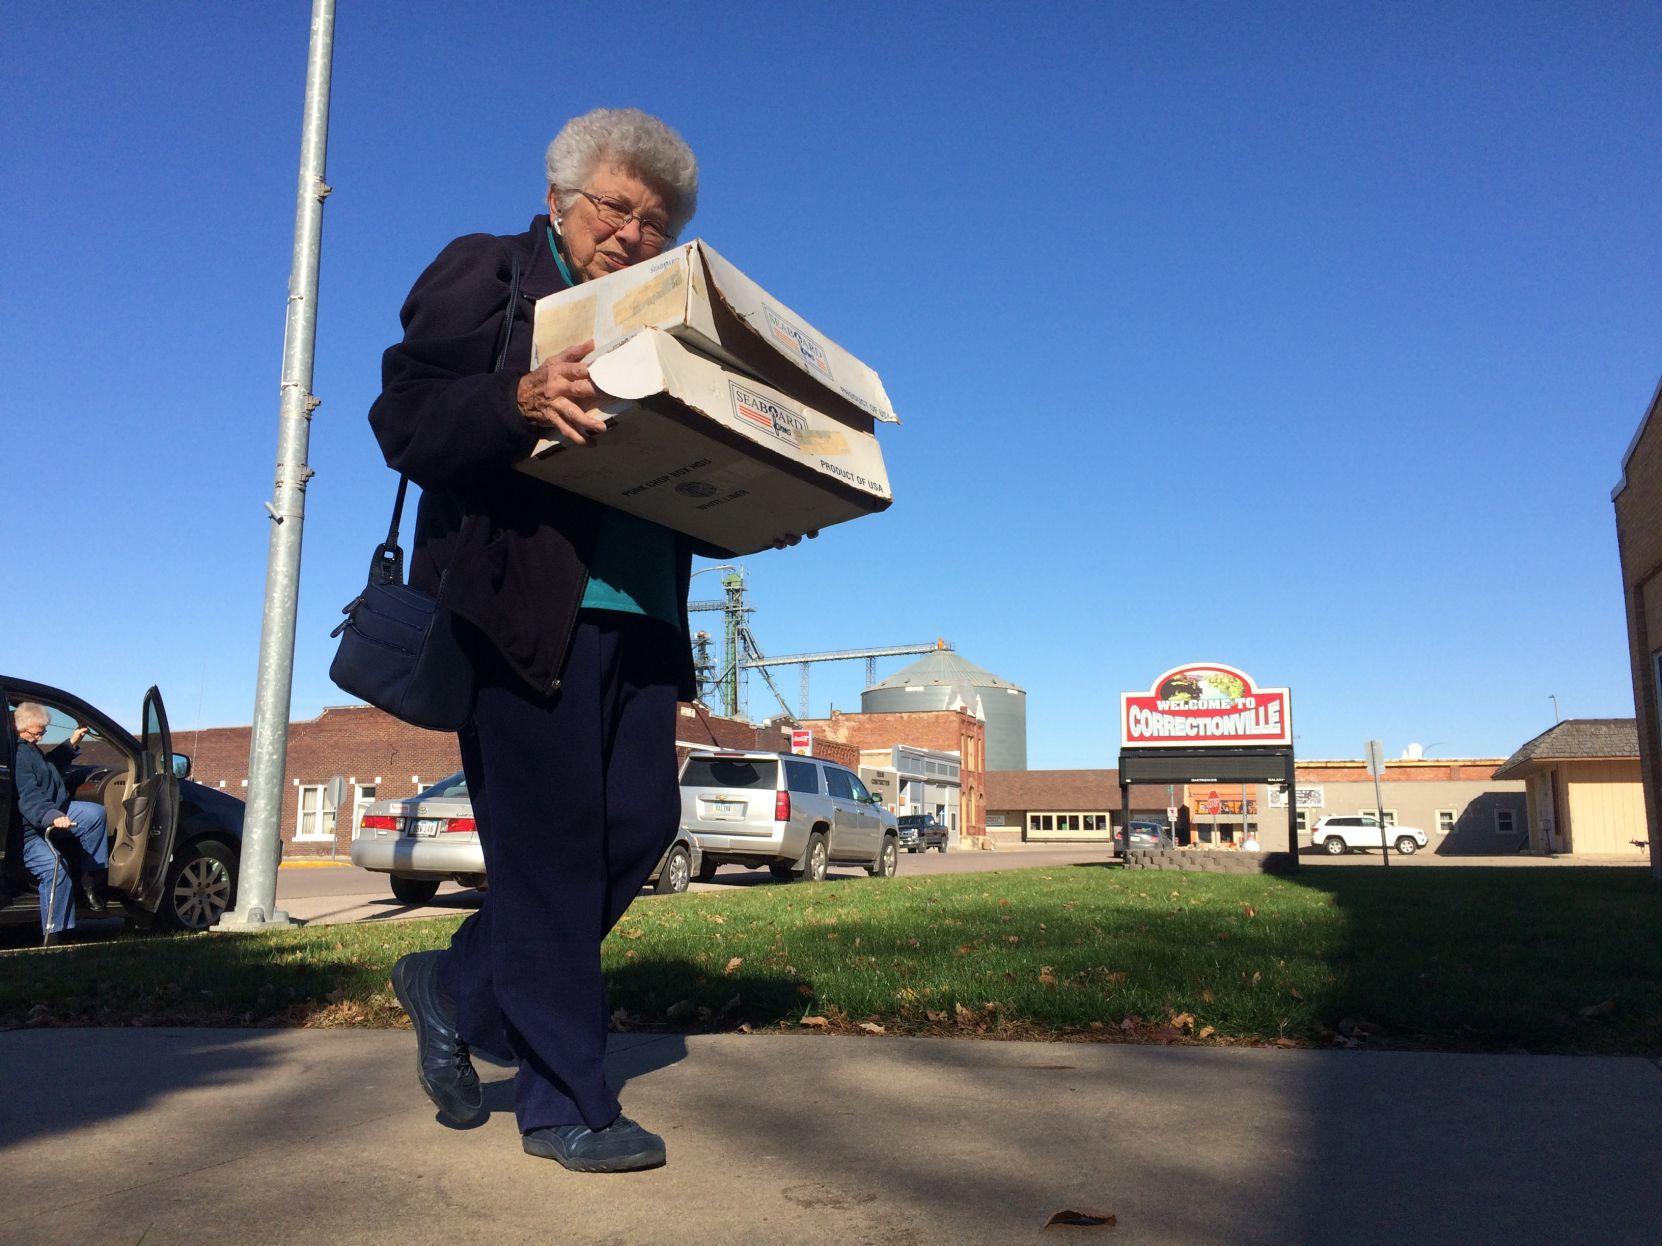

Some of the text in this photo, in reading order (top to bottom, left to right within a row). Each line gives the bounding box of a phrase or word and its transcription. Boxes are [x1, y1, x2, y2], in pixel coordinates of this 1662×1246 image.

[768, 312, 822, 358] SEABOARD
[736, 390, 803, 430] SEABOARD
[840, 386, 890, 420] PRODUCT OF USA
[820, 460, 884, 493] PRODUCT OF USA
[1129, 699, 1281, 738] CORRECTIONVILLE
[1156, 697, 1256, 711] WELCOME TO
[1208, 797, 1220, 807] STOP
